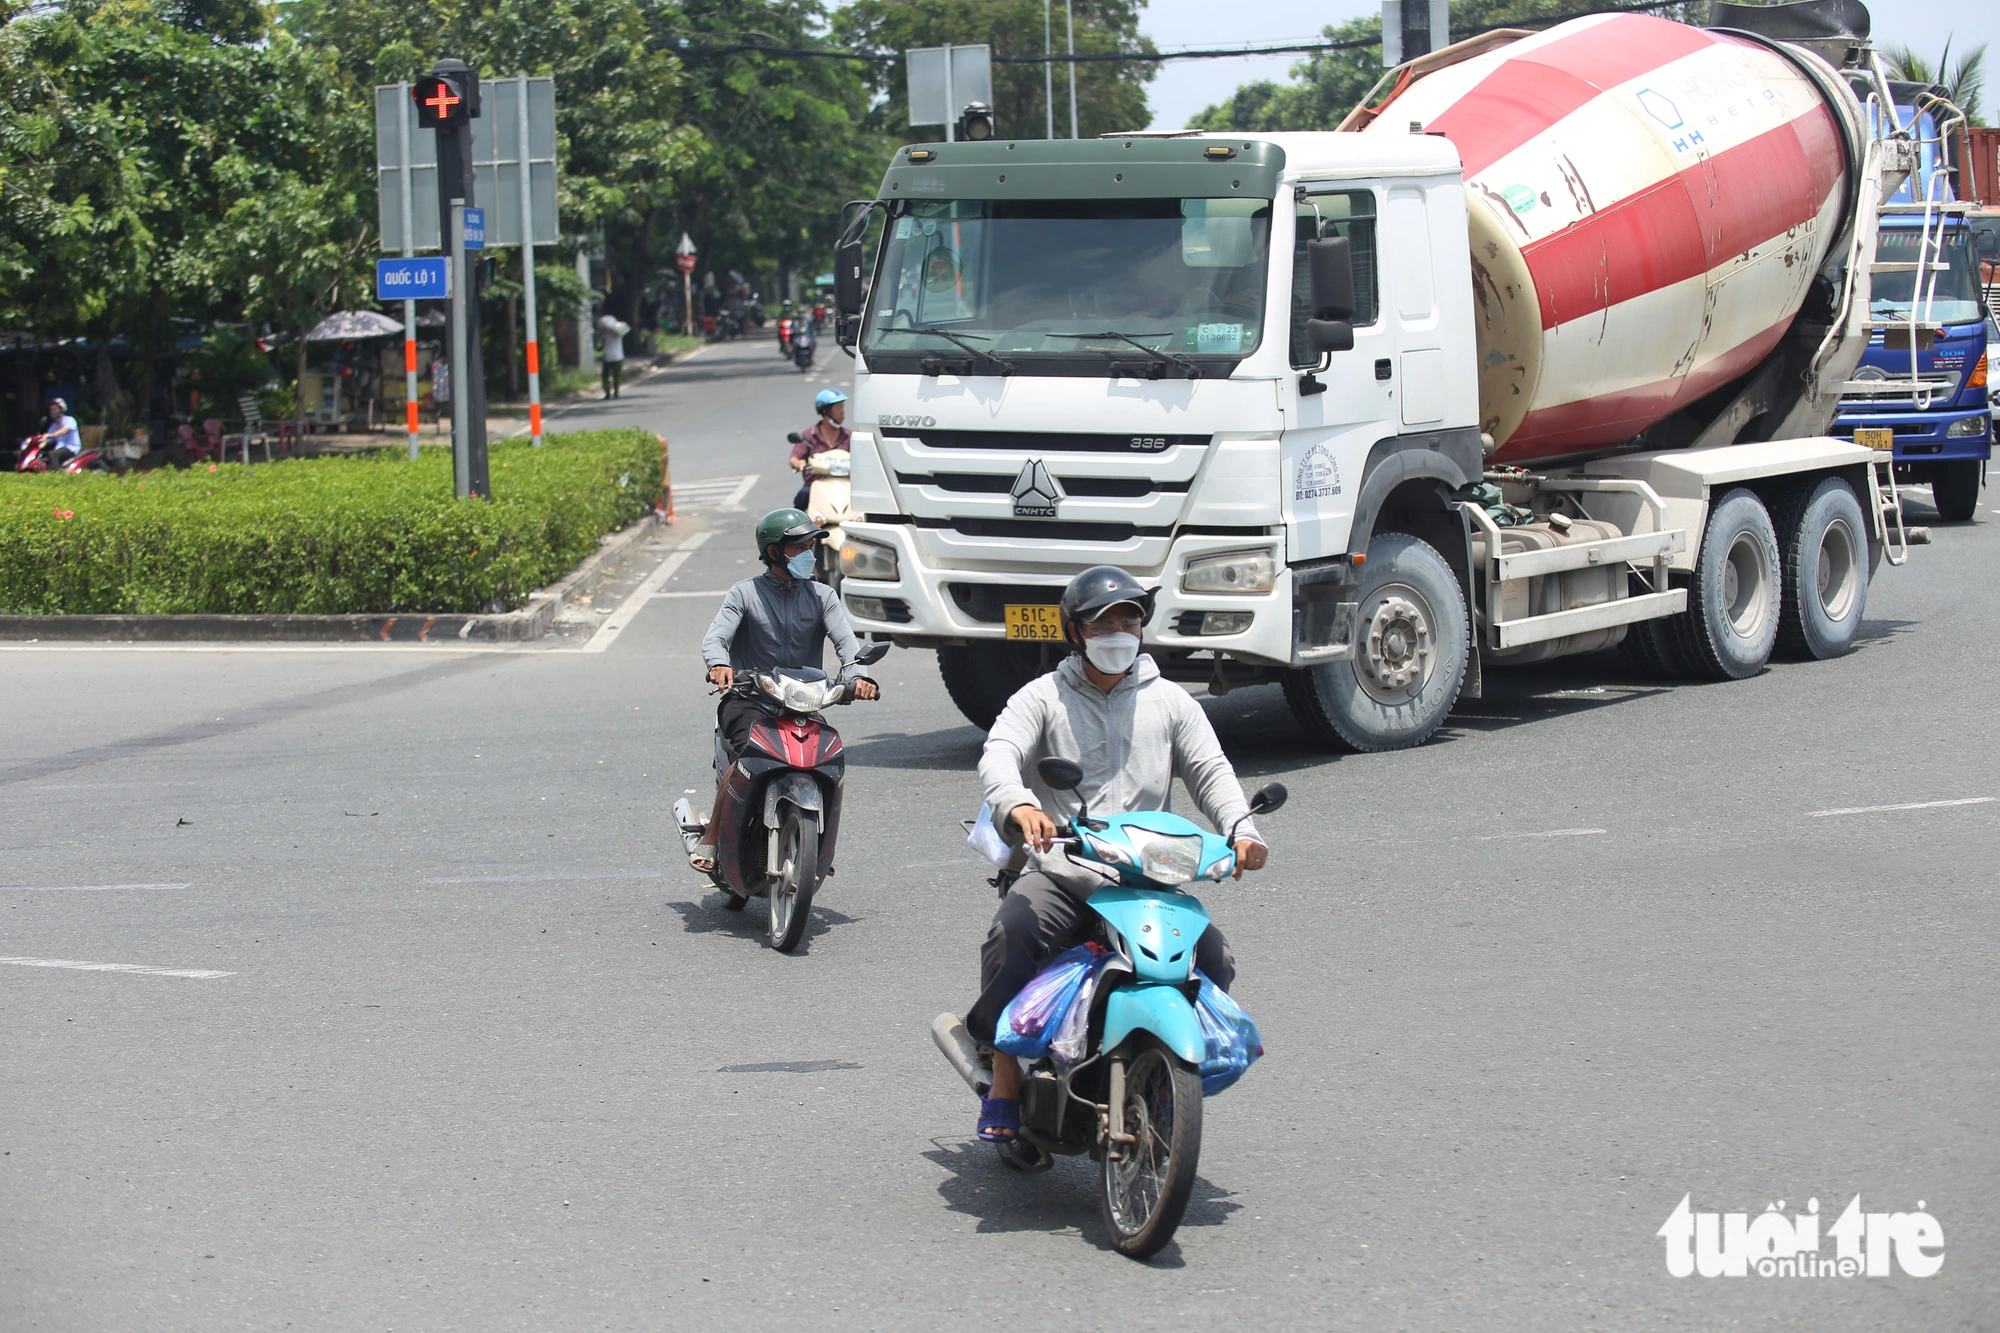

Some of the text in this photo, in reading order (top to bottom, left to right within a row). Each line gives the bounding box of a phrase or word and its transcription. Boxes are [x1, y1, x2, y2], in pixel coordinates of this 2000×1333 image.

[385, 268, 436, 286] QUỐC LỘ 1
[878, 414, 936, 427] HOWO
[1865, 430, 1882, 440] 50H
[1130, 437, 1166, 449] 336
[1015, 507, 1055, 516] CNHTC
[1021, 608, 1046, 622] 61C
[1013, 624, 1057, 638] 306.92
